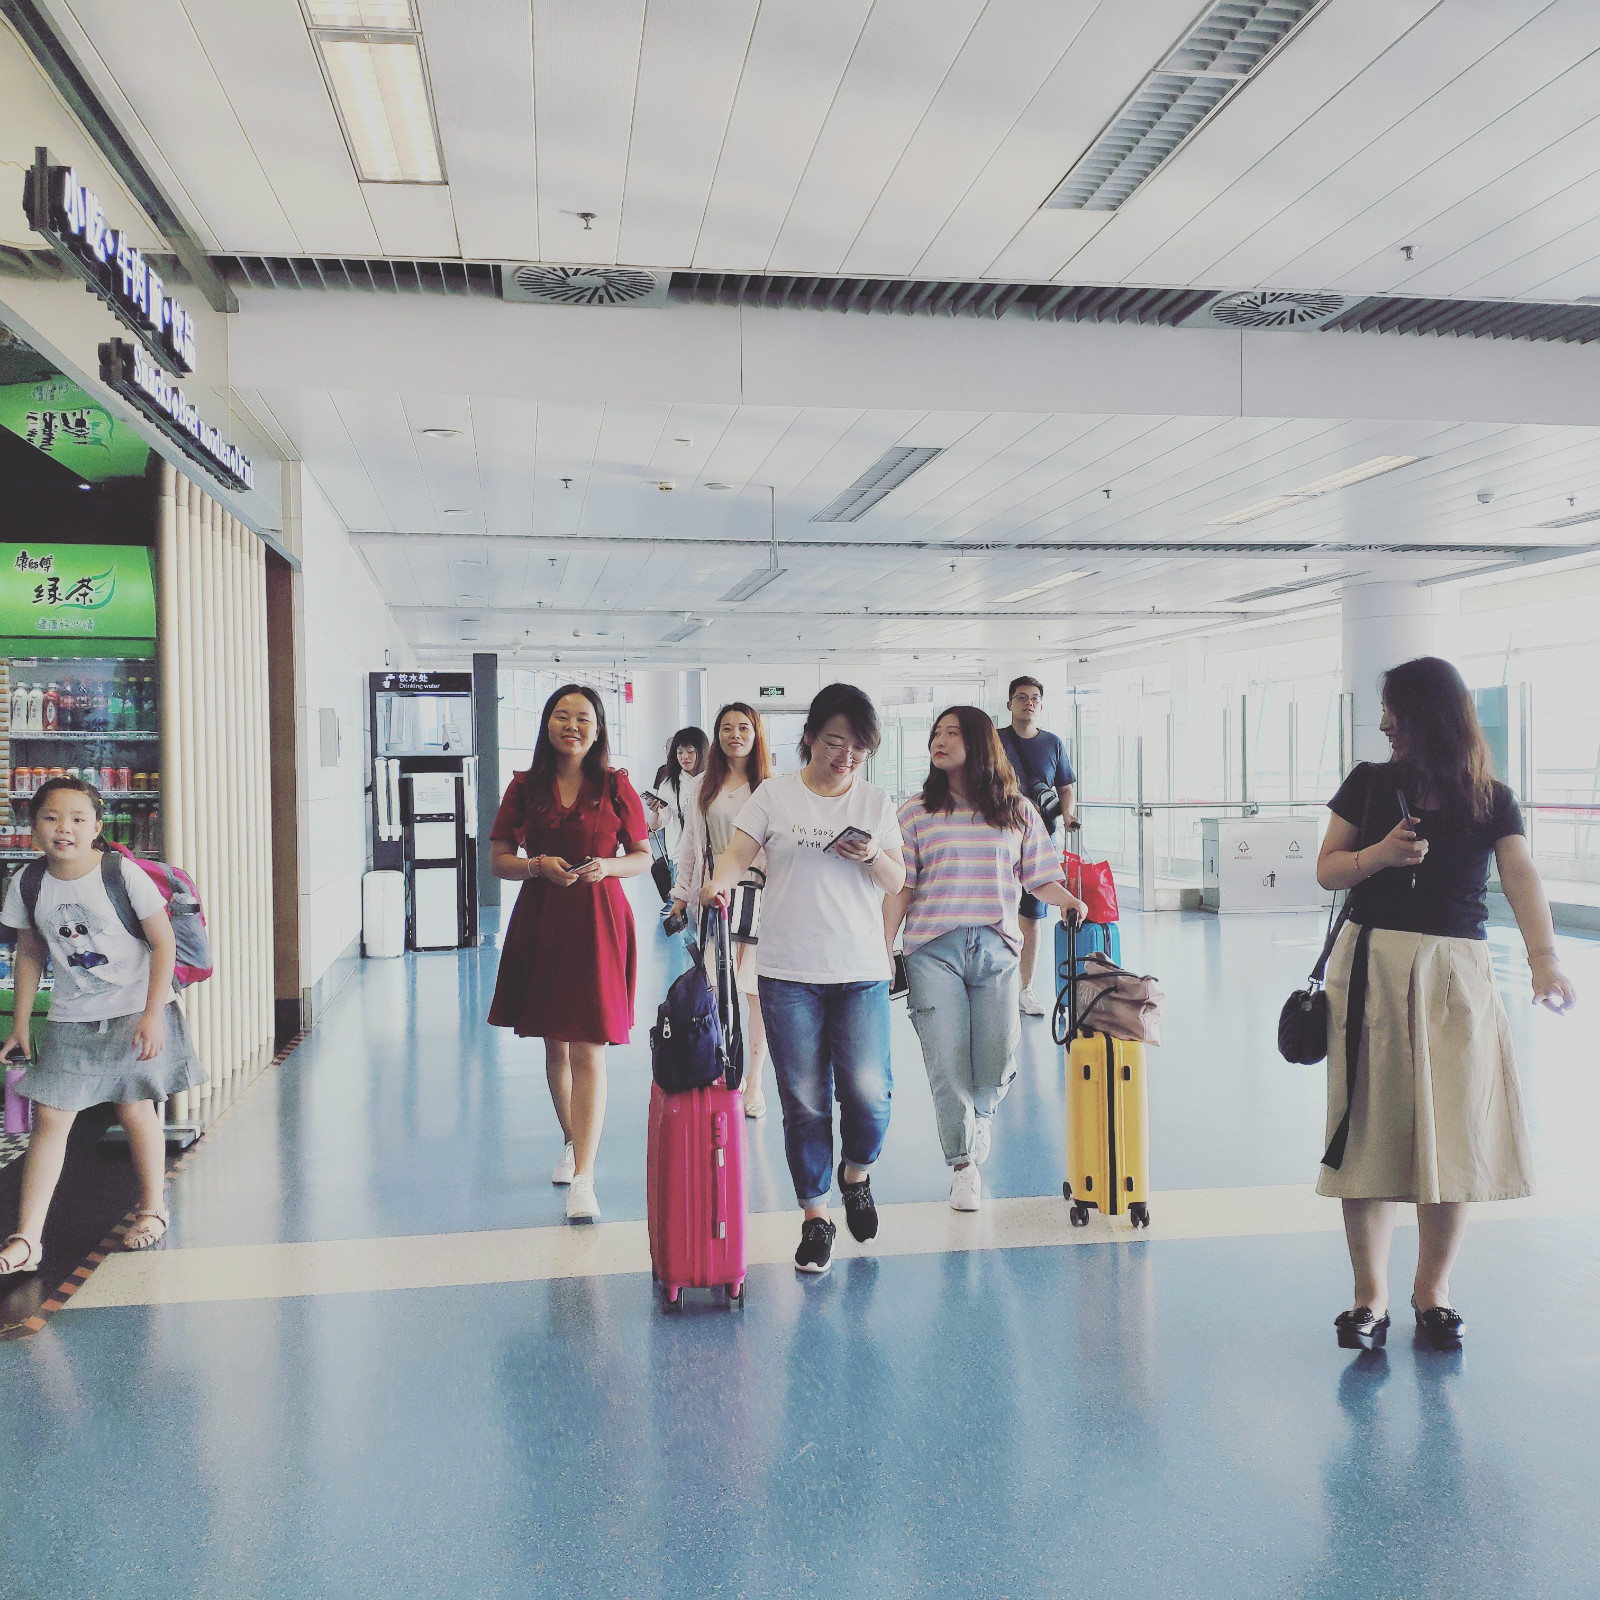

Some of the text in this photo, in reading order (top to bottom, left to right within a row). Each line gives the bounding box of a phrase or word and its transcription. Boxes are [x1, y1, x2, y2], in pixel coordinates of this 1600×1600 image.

[32, 576, 94, 606] 绿茶
[398, 673, 429, 683] 饮水处
[398, 682, 424, 690] Drinking
